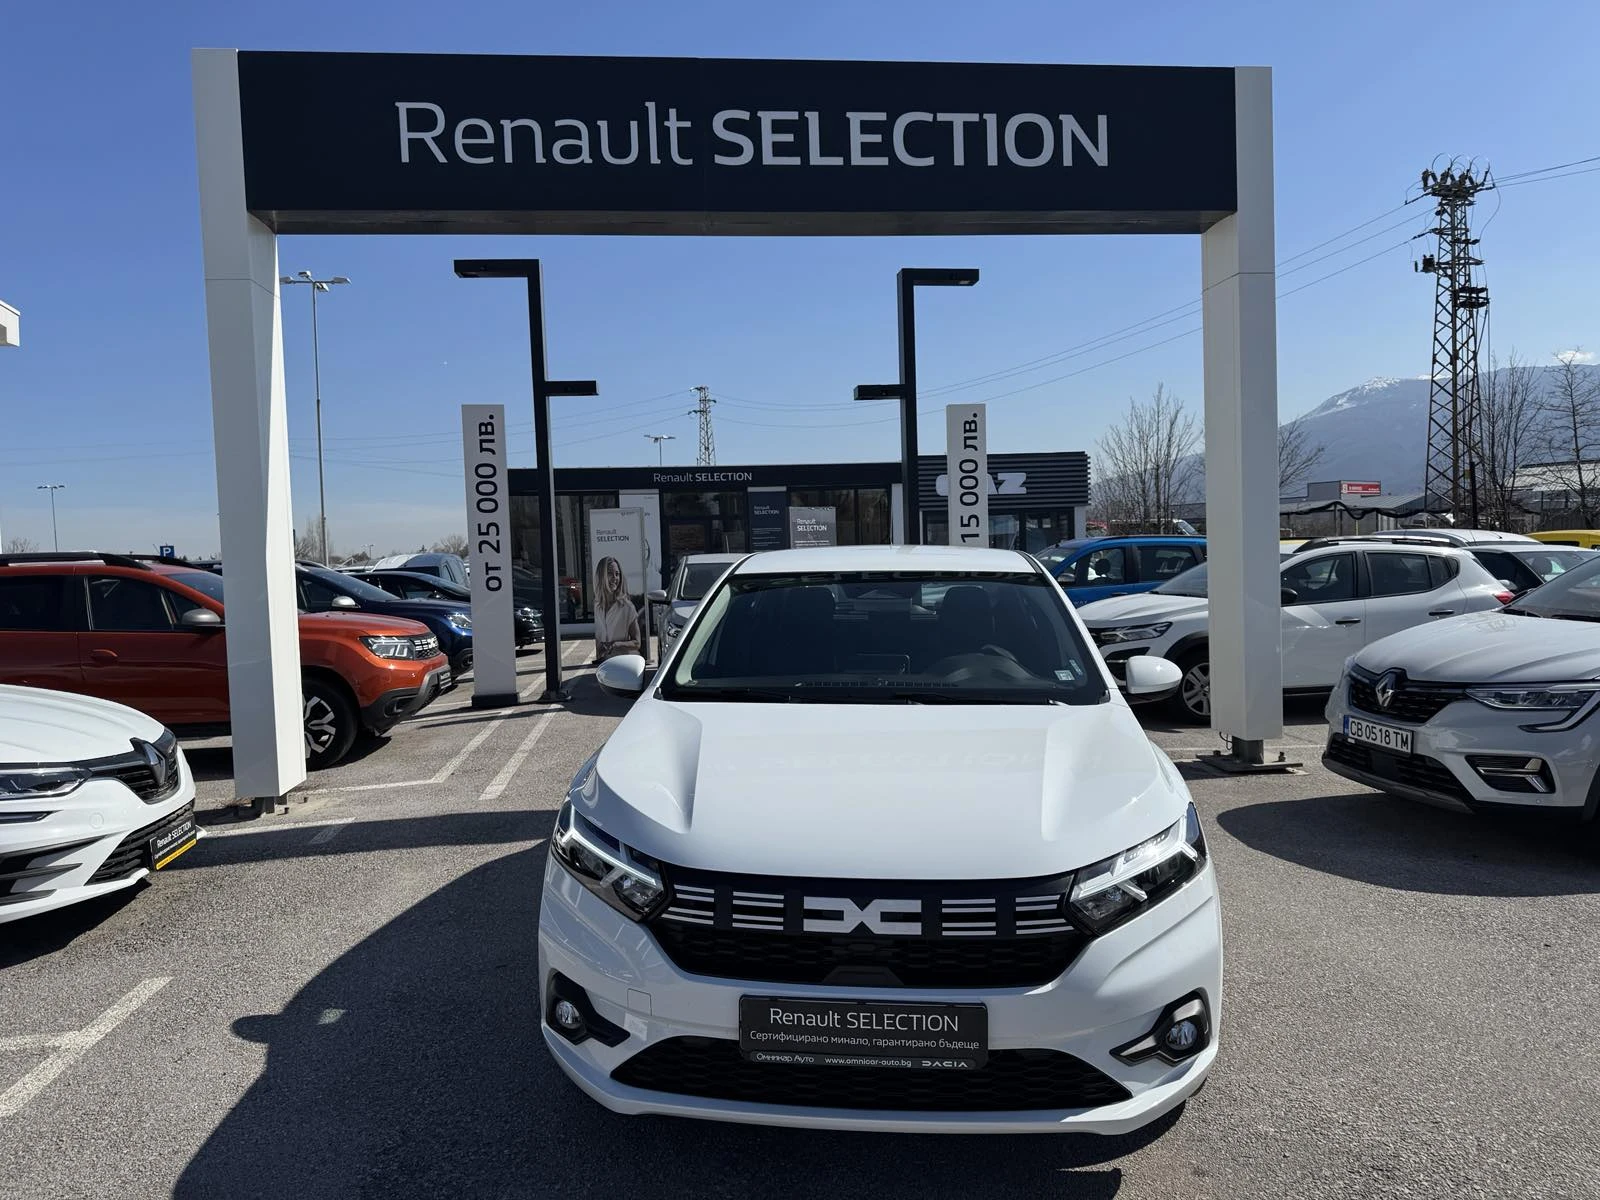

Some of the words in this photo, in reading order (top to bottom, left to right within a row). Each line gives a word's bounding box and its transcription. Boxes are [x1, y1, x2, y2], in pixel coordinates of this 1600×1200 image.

[395, 101, 694, 165] Renault
[712, 109, 1109, 167] SELECTION
[479, 414, 496, 456] лв.
[963, 412, 978, 452] лв.
[474, 462, 499, 514] 000
[653, 473, 693, 482] Renault
[695, 472, 752, 482] SELECTION
[959, 458, 979, 507] 000
[478, 522, 500, 554] 25
[596, 535, 630, 543] SELECTION
[960, 514, 980, 543] 15
[485, 562, 502, 592] от
[1365, 725, 1391, 744] 0518
[171, 821, 191, 839] SELECTION
[769, 1007, 841, 1029] Renault
[846, 1011, 960, 1032] SELECTION
[750, 1030, 830, 1044] Сертифицирано
[831, 1035, 871, 1047] минало,
[873, 1037, 937, 1049] гарантирано
[938, 1038, 980, 1050] бъдеще
[794, 1055, 815, 1064] Ауто
[824, 1057, 912, 1068] www.omnicar-auto.bg
[921, 1060, 969, 1068] DACIA
